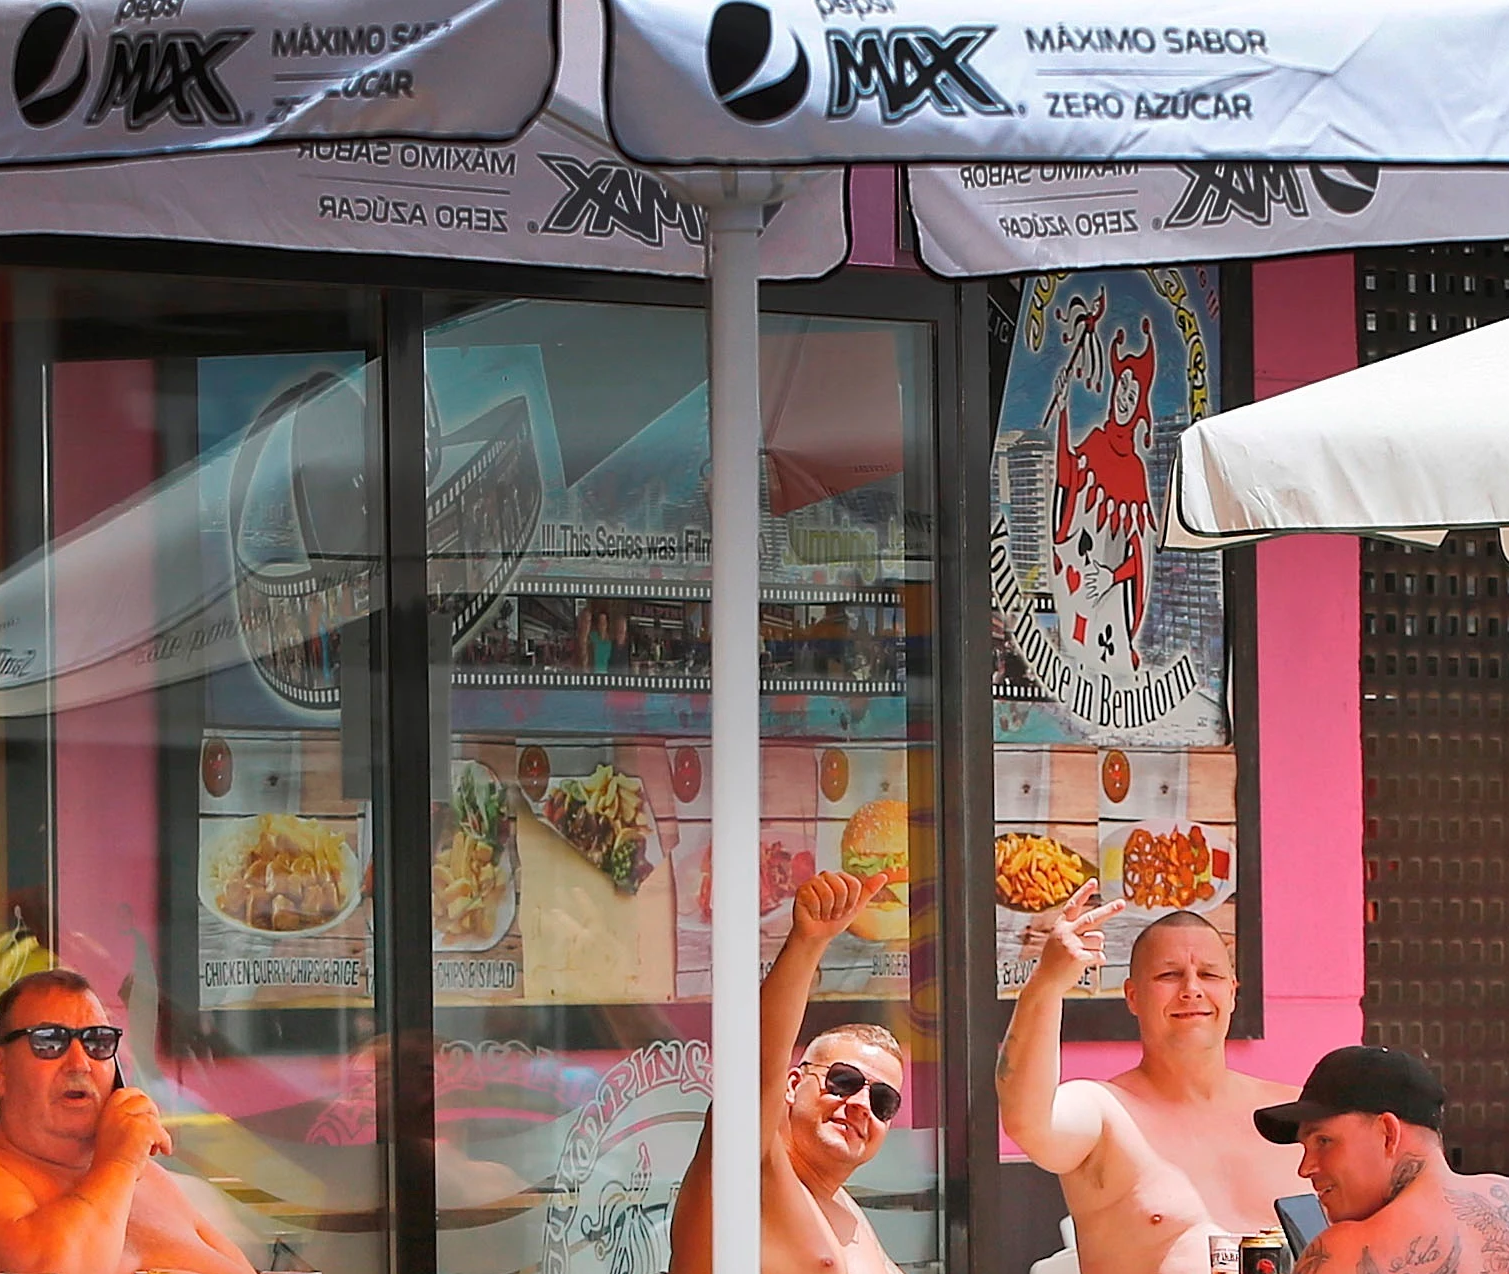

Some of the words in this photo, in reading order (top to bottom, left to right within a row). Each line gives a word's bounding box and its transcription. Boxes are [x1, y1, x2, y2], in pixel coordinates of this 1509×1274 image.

[271, 23, 386, 57] MÁXIMO
[1025, 25, 1158, 55] MÁXIMO
[1164, 27, 1269, 56] SABOR
[88, 27, 256, 132] MAX
[825, 27, 1013, 121] MAX
[1047, 92, 1124, 121] ZERO
[1133, 82, 1252, 122] AZÚCAR
[560, 525, 591, 558] This
[595, 526, 643, 560] Series
[646, 535, 677, 561] was
[684, 529, 713, 564] Film
[1013, 598, 1072, 704] house
[1072, 663, 1094, 722] in
[1098, 653, 1198, 730] Benidorm
[205, 960, 251, 988] CHICKEN
[253, 960, 288, 987] CURRY
[290, 960, 321, 987] CHIPS
[333, 959, 360, 987] RICE
[479, 961, 516, 989] SALAD
